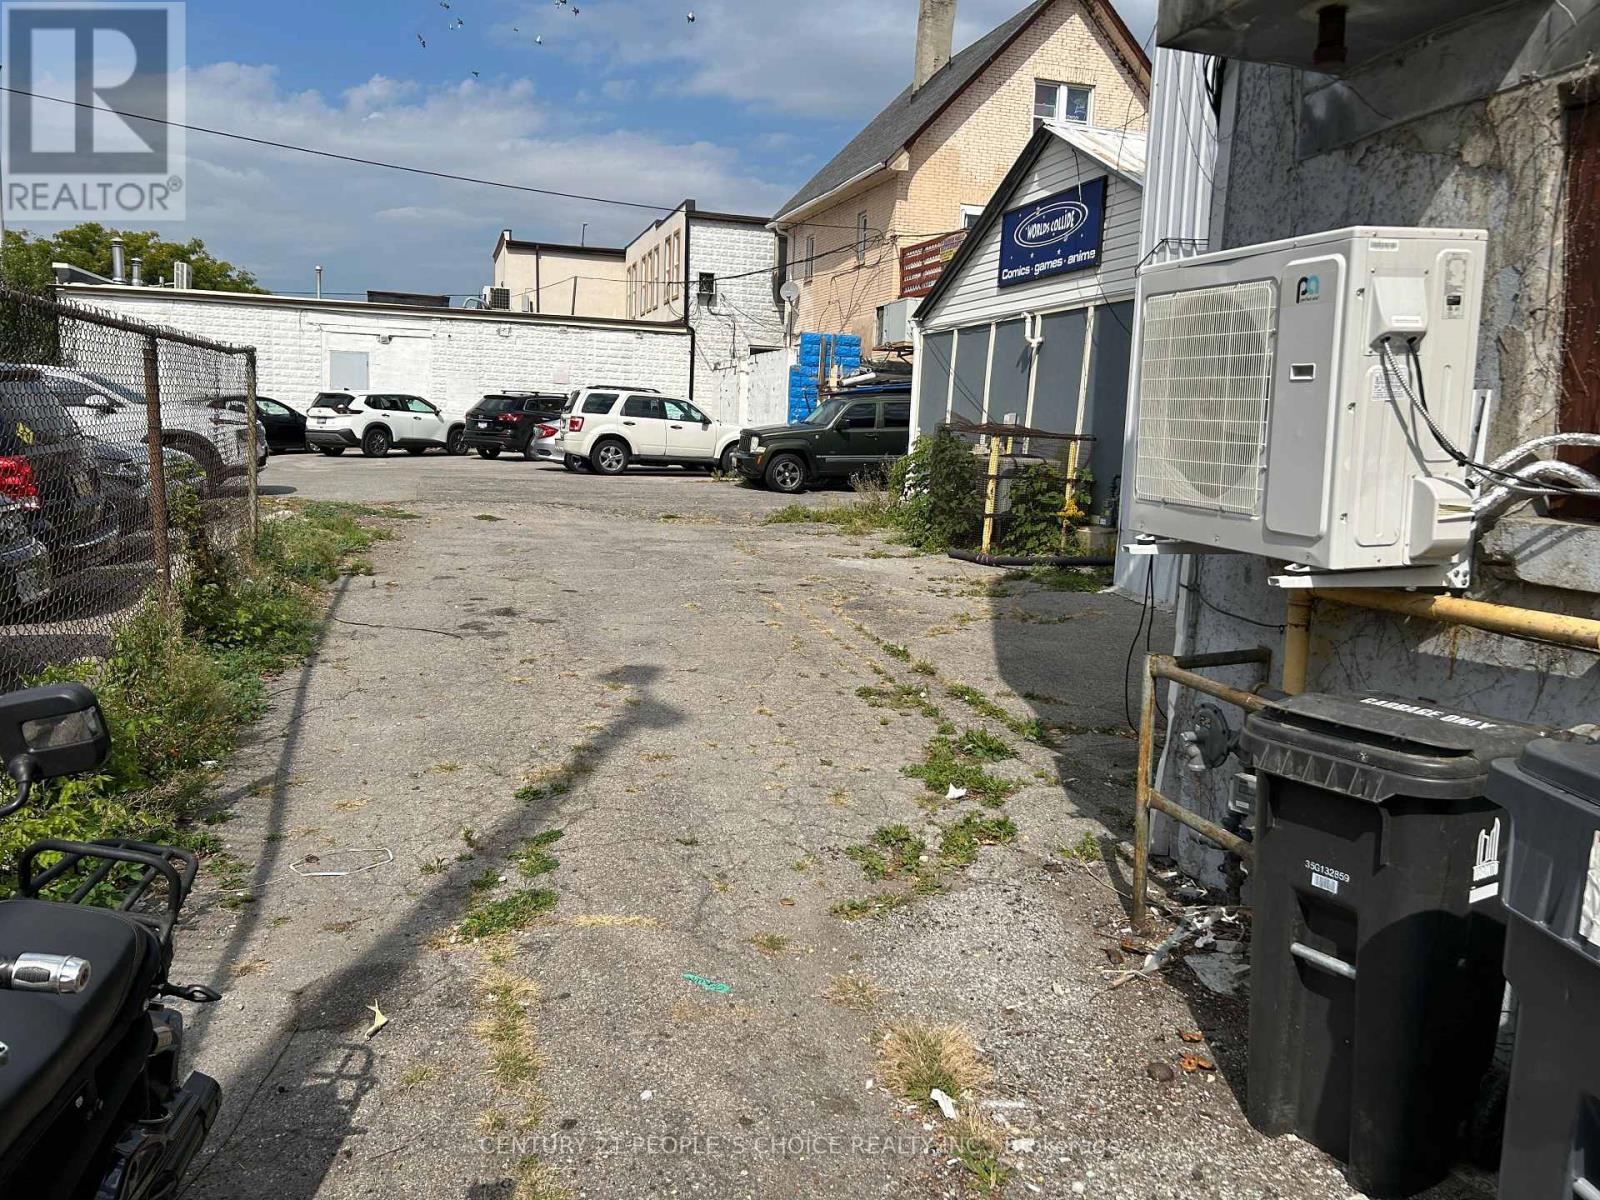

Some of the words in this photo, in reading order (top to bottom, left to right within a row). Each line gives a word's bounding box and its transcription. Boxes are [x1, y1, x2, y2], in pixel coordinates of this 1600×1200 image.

[1027, 222, 1050, 240] WORLDS
[1050, 209, 1075, 231] COLLIDE
[1002, 265, 1030, 280] Comics
[1034, 259, 1063, 275] games
[1067, 248, 1096, 264] anime
[1360, 697, 1444, 717] GARBAGE
[1440, 714, 1497, 729] ONLY
